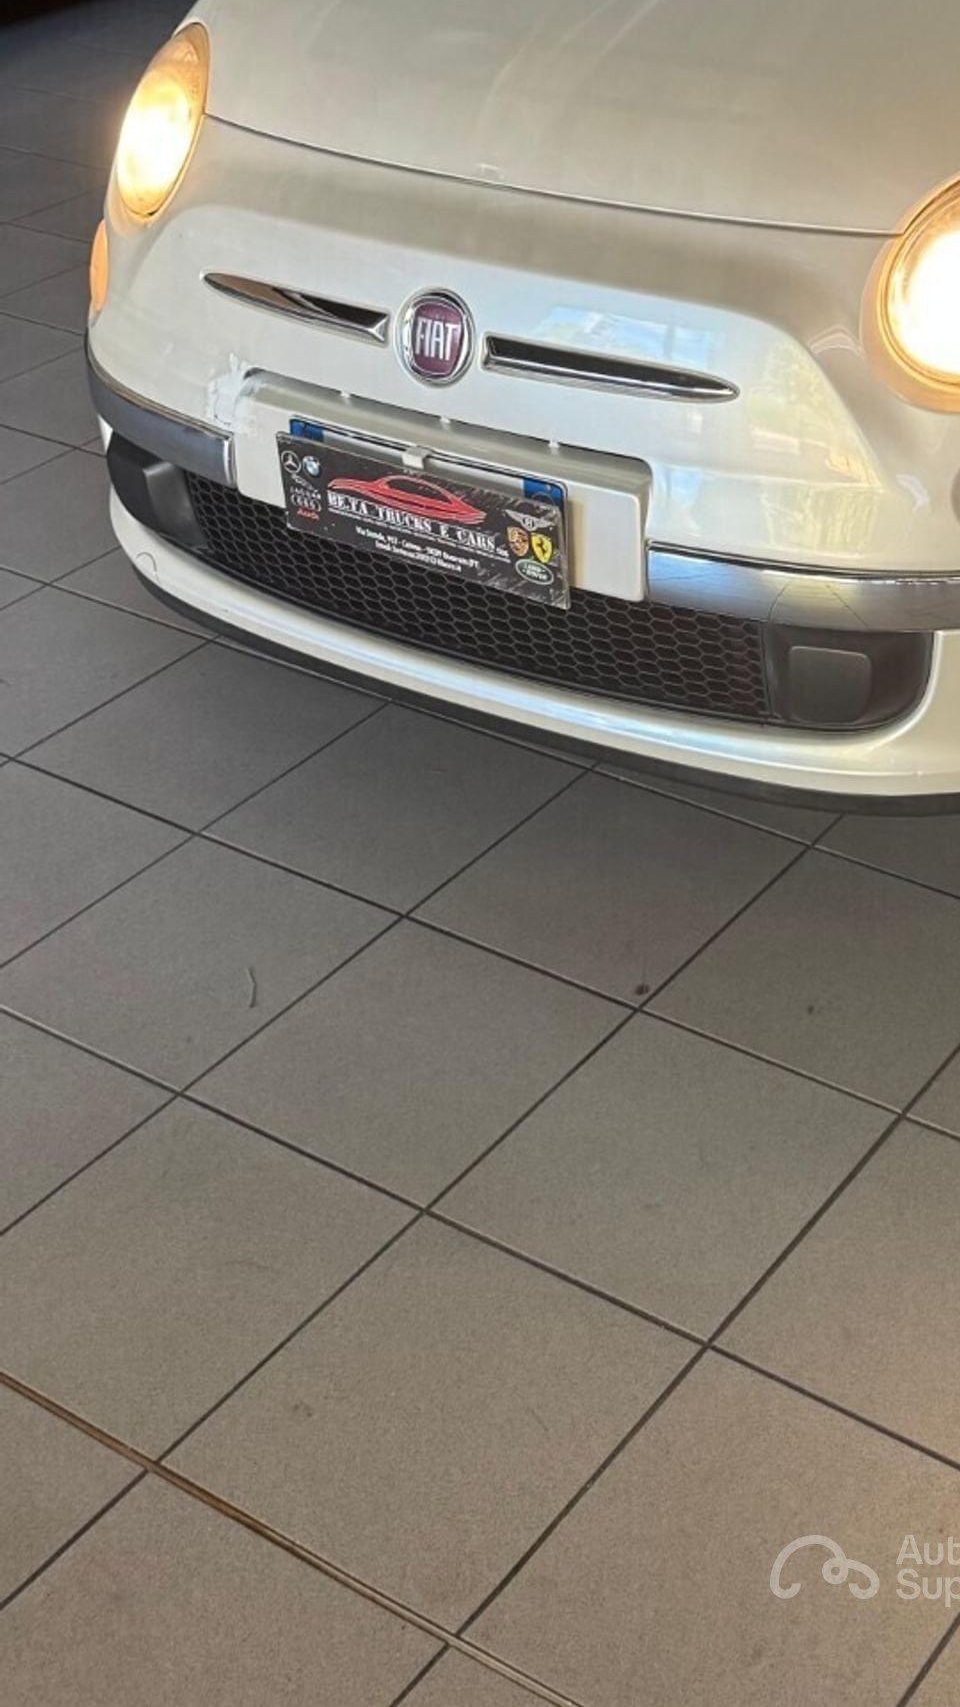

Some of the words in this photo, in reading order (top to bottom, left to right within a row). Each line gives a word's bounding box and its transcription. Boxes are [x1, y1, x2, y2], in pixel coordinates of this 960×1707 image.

[415, 317, 461, 361] FIAT
[375, 504, 432, 532] TRUCKS
[440, 525, 449, 538] E
[457, 529, 496, 551] CARS
